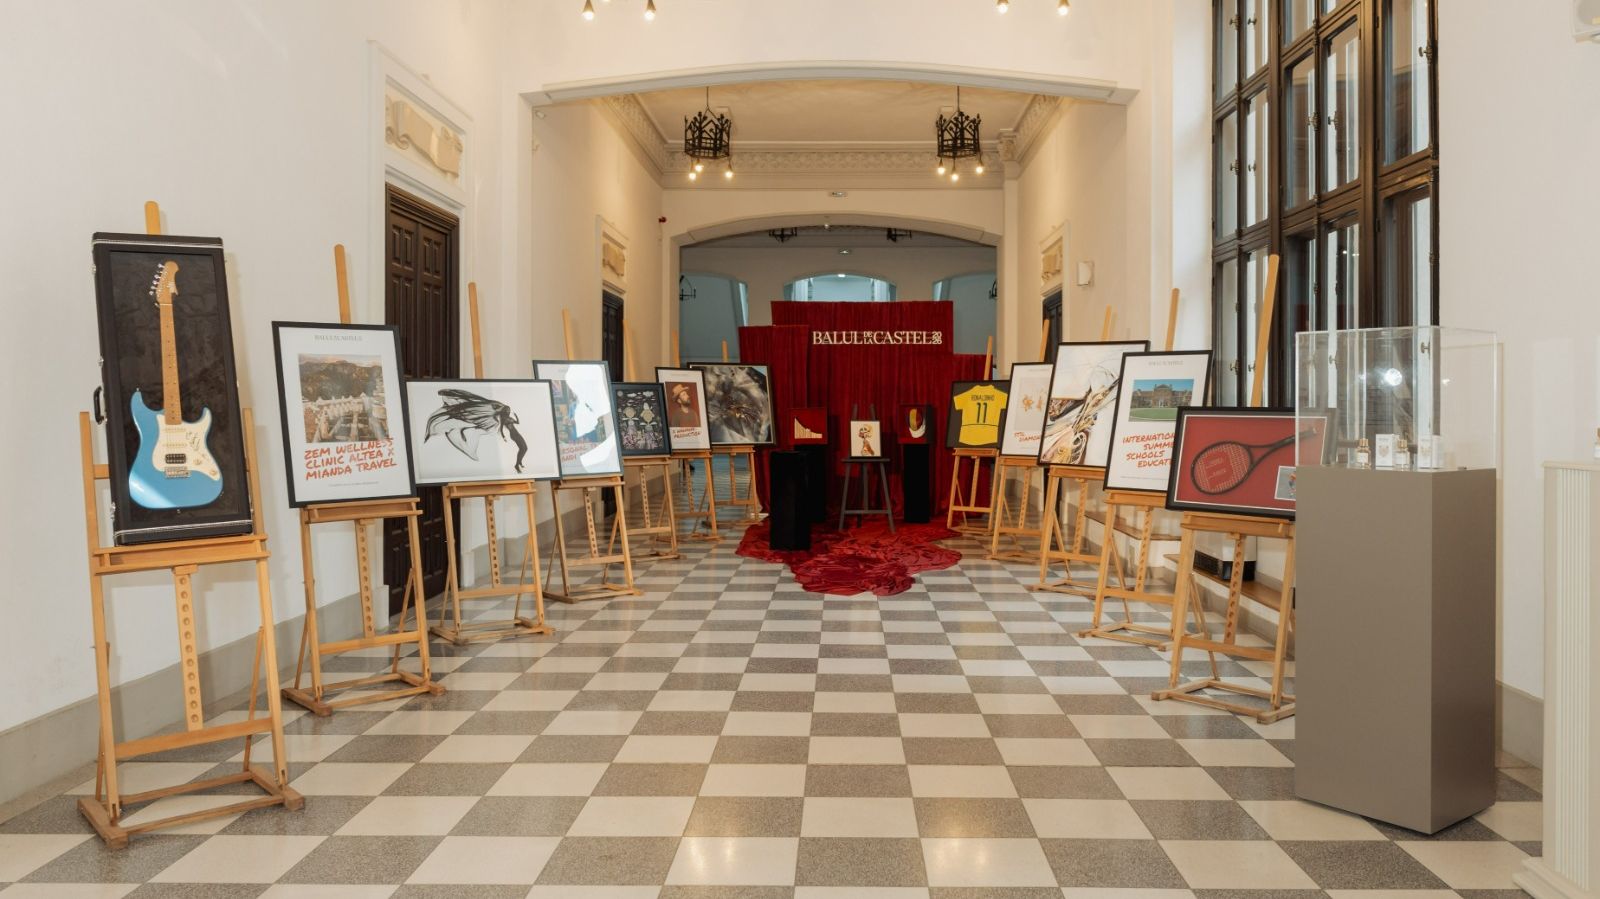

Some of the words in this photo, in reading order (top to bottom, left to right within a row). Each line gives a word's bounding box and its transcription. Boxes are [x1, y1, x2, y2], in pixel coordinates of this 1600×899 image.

[812, 331, 863, 345] BALUL
[863, 337, 873, 345] LA
[873, 331, 932, 345] CASTEL
[976, 402, 988, 424] 11
[304, 447, 331, 460] ZEM
[336, 437, 394, 454] WELLNESS
[1126, 450, 1165, 461] SCHOOLS
[305, 455, 345, 470] CLINIC
[349, 449, 384, 463] ALTEA
[306, 464, 353, 481] MIANDA
[356, 457, 398, 472] TRAVEL
